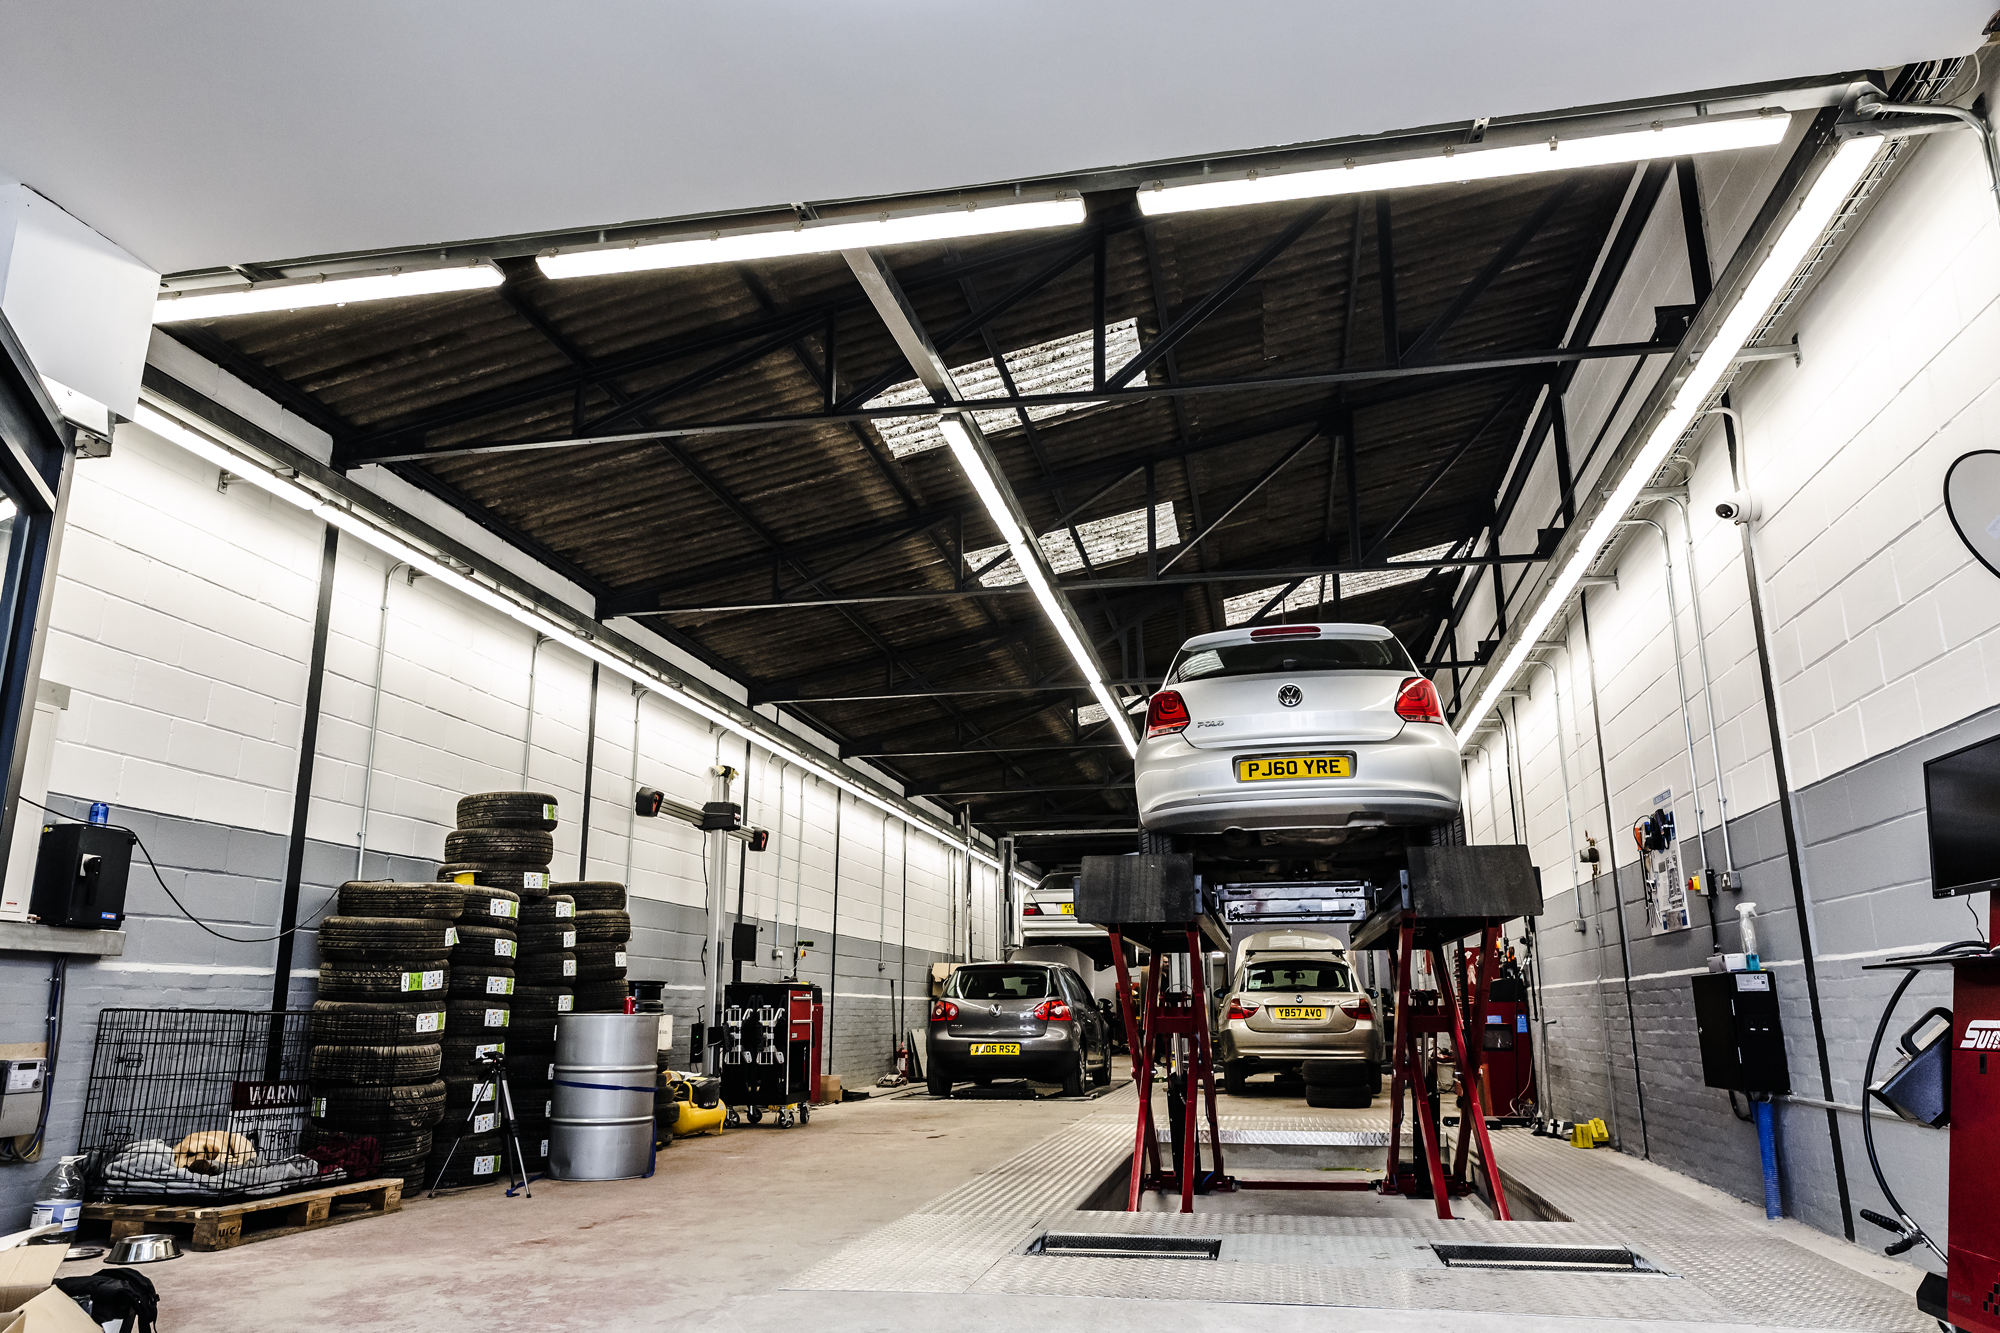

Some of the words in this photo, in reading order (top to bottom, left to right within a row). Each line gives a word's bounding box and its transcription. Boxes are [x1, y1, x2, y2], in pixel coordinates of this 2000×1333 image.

[1248, 760, 1298, 777] PJ60
[1303, 759, 1341, 774] YRE
[1278, 1008, 1302, 1017] YB57
[1304, 1008, 1322, 1017] AVO
[999, 1045, 1017, 1054] RSZ
